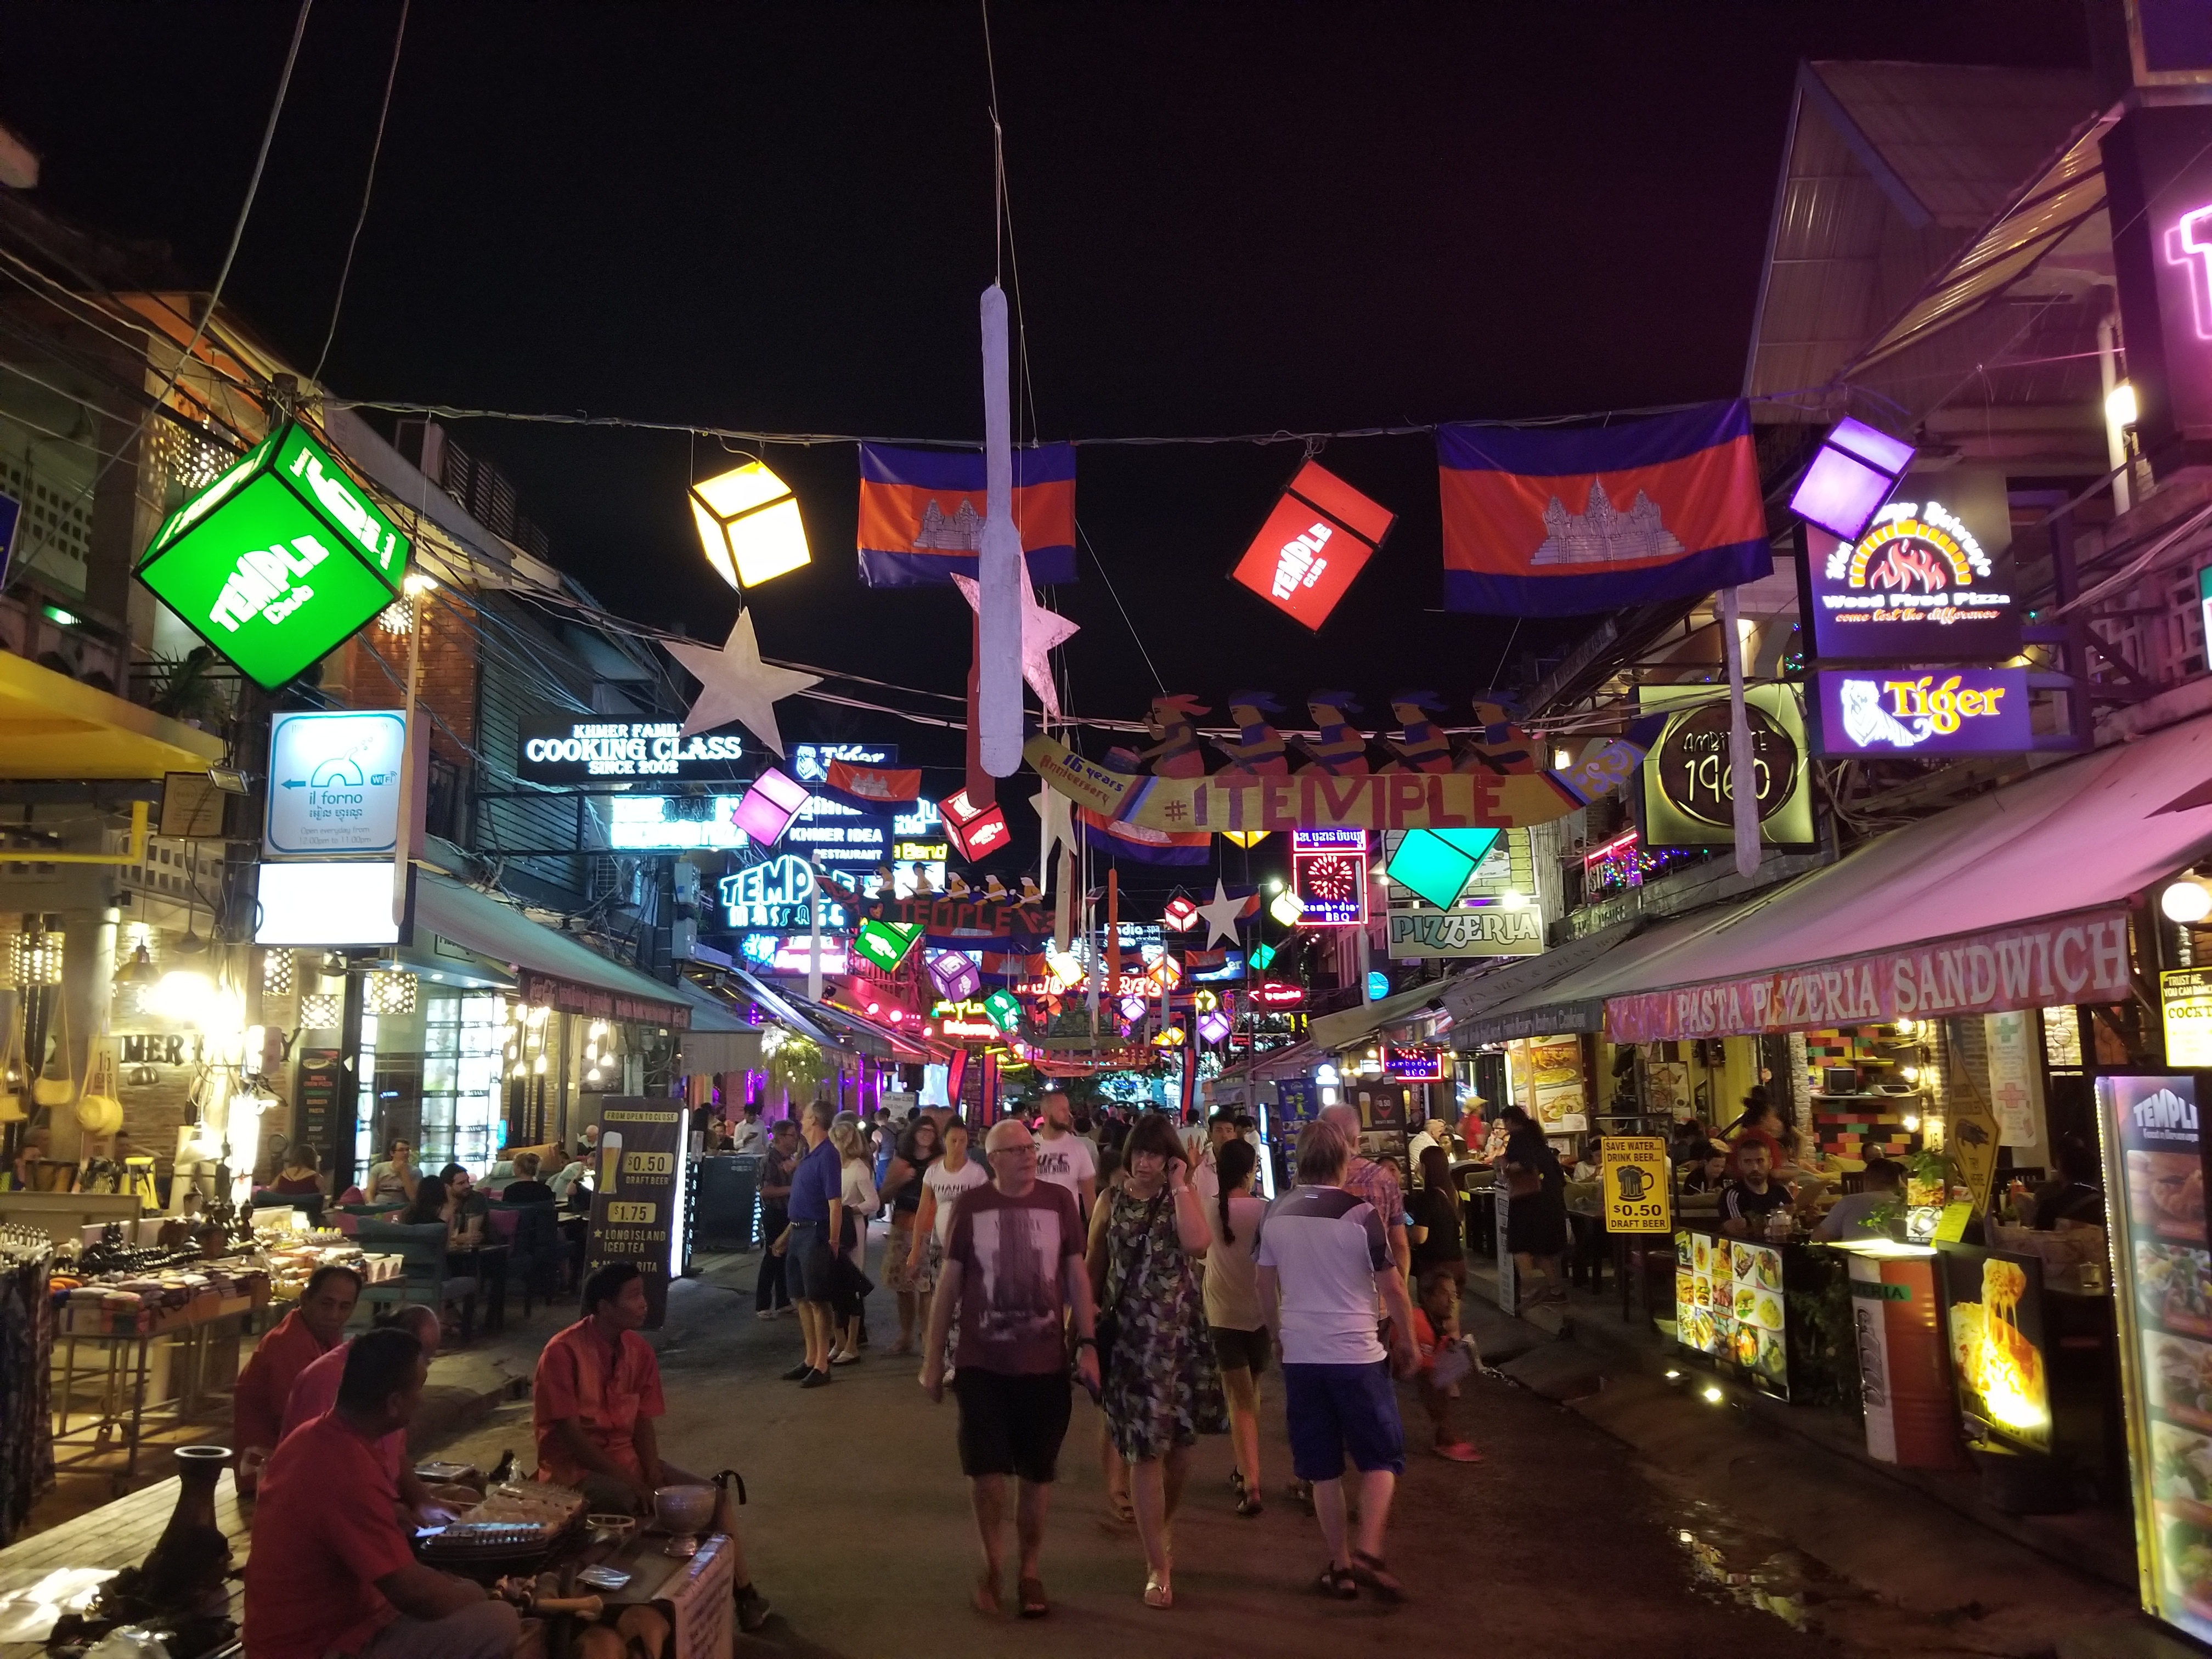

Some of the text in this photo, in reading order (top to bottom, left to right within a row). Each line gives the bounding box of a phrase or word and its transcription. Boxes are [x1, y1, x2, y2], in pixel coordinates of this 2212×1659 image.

[1272, 522, 1333, 601] TEMPLE
[209, 535, 330, 633] TEMPLE
[1822, 594, 1885, 608] Wood
[1954, 592, 2011, 606] Pizza
[1884, 675, 2006, 733] Tiger
[573, 723, 685, 738] KHMER FAMIL
[527, 736, 742, 763] COOKING CLASS
[589, 759, 679, 774] SINCE 2002
[1086, 766, 1124, 793] years
[309, 791, 363, 805] il forno
[790, 827, 883, 843] KHMER IDEA
[894, 899, 1012, 935] TEMPLE
[1325, 912, 1350, 922] BBQ
[1391, 913, 1539, 949] PIZZERIA
[1677, 988, 1743, 1033] PASTA
[1893, 917, 2129, 1013] SANDWICH
[2164, 988, 2178, 997] YOU
[2179, 986, 2192, 996] CAN
[1606, 1142, 1626, 1150] SAVE
[628, 1156, 665, 1171] $0.50
[1607, 1153, 1632, 1162] DRINK
[625, 1175, 669, 1185] DRAFT BEER
[614, 1206, 647, 1221] $1.75
[1613, 1204, 1662, 1216] $0.50
[1611, 1220, 1665, 1228] DRAFT BEER
[605, 1229, 665, 1242] LONG ISLAND
[603, 1242, 645, 1254] ICED TEA
